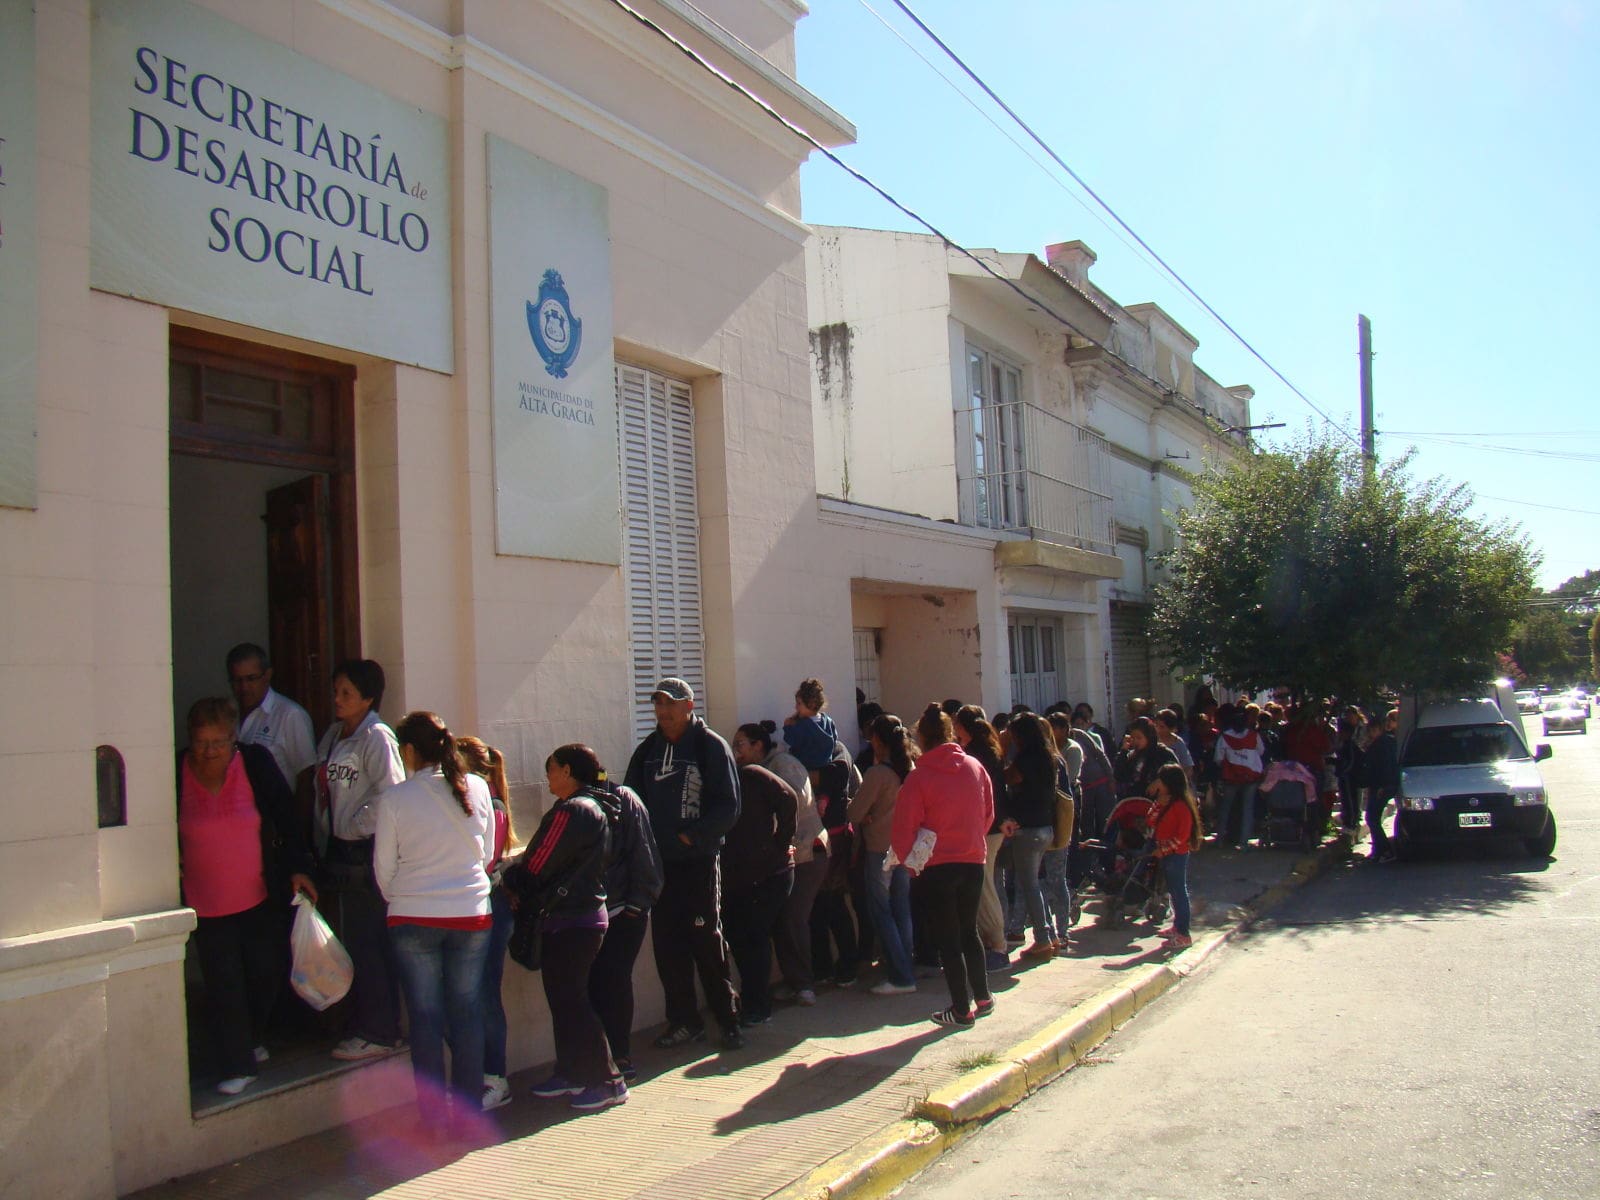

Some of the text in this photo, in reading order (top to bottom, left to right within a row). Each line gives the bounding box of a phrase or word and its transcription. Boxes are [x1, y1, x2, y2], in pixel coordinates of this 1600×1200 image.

[134, 46, 428, 201] SECRETARÍA de
[128, 107, 429, 252] DESARROLLO
[208, 207, 374, 296] SOCIAL
[518, 381, 594, 410] MUNICIPALIDAD DE
[519, 394, 595, 426] ALTA GRACIA
[687, 764, 703, 818] NIKE
